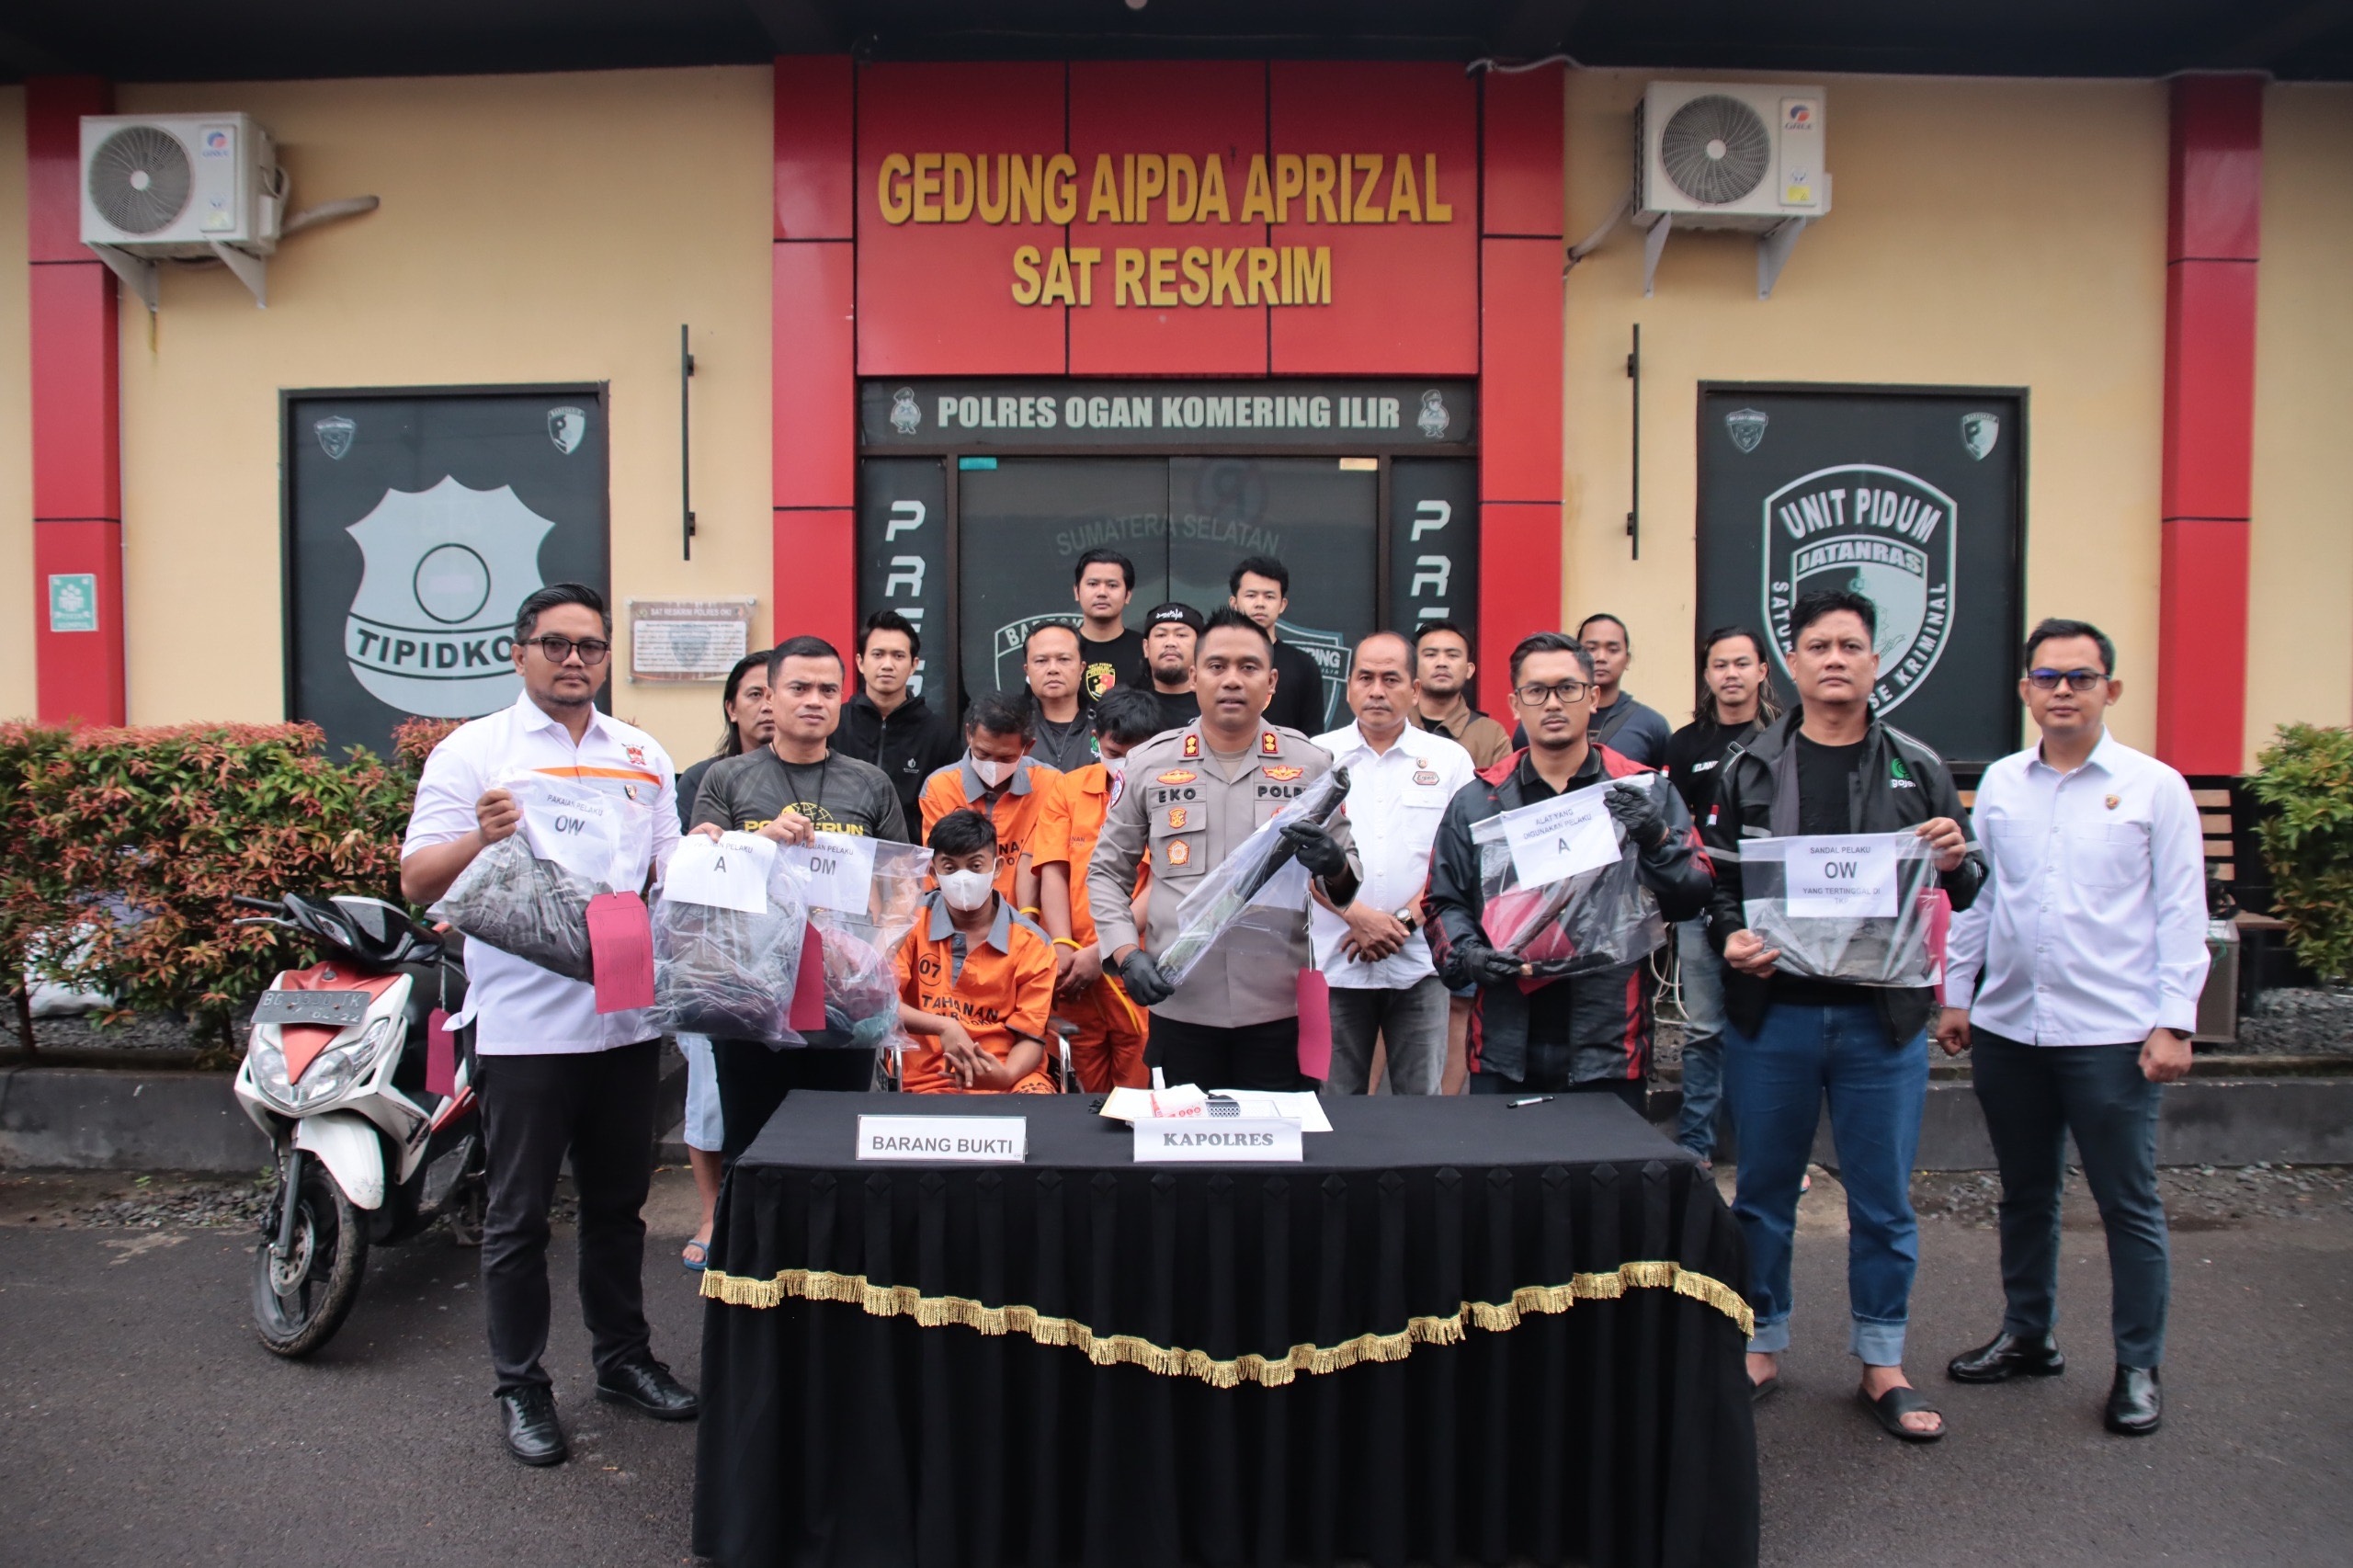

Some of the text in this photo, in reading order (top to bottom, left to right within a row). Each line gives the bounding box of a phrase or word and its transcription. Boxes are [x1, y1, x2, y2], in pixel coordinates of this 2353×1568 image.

[879, 153, 1452, 225] GEDUNG AIPDA APRIZAL
[1012, 245, 1331, 307] SAT RESKRIM
[938, 396, 1400, 429] POLRES OGAN KOMERING ILIR
[1779, 488, 1942, 544] UNIT PIDUM
[1057, 513, 1279, 557] SUMATERA SELATAN
[1798, 541, 1922, 574] JATANRAS
[1893, 583, 1947, 687] KRIMINAL
[357, 627, 515, 669] TIPIDKO
[547, 794, 604, 817] PAKAIAN PELAKU
[1158, 787, 1197, 803] EKO
[554, 814, 585, 836] OW
[1523, 813, 1592, 840] DIGUNAKAN PELAKU
[1536, 809, 1574, 825] ALAT YANG
[725, 843, 754, 854] PELAKU
[827, 845, 854, 856] PELAKU
[1558, 837, 1571, 855] A
[713, 856, 727, 873] A
[810, 857, 836, 876] DM
[1824, 861, 1858, 880] OW
[919, 959, 941, 979] 07
[263, 994, 284, 1006] BG
[922, 994, 999, 1021] TAHANAN
[872, 1136, 1013, 1154] BARANG BUKTI
[1164, 1133, 1274, 1147] KAPOLRES
